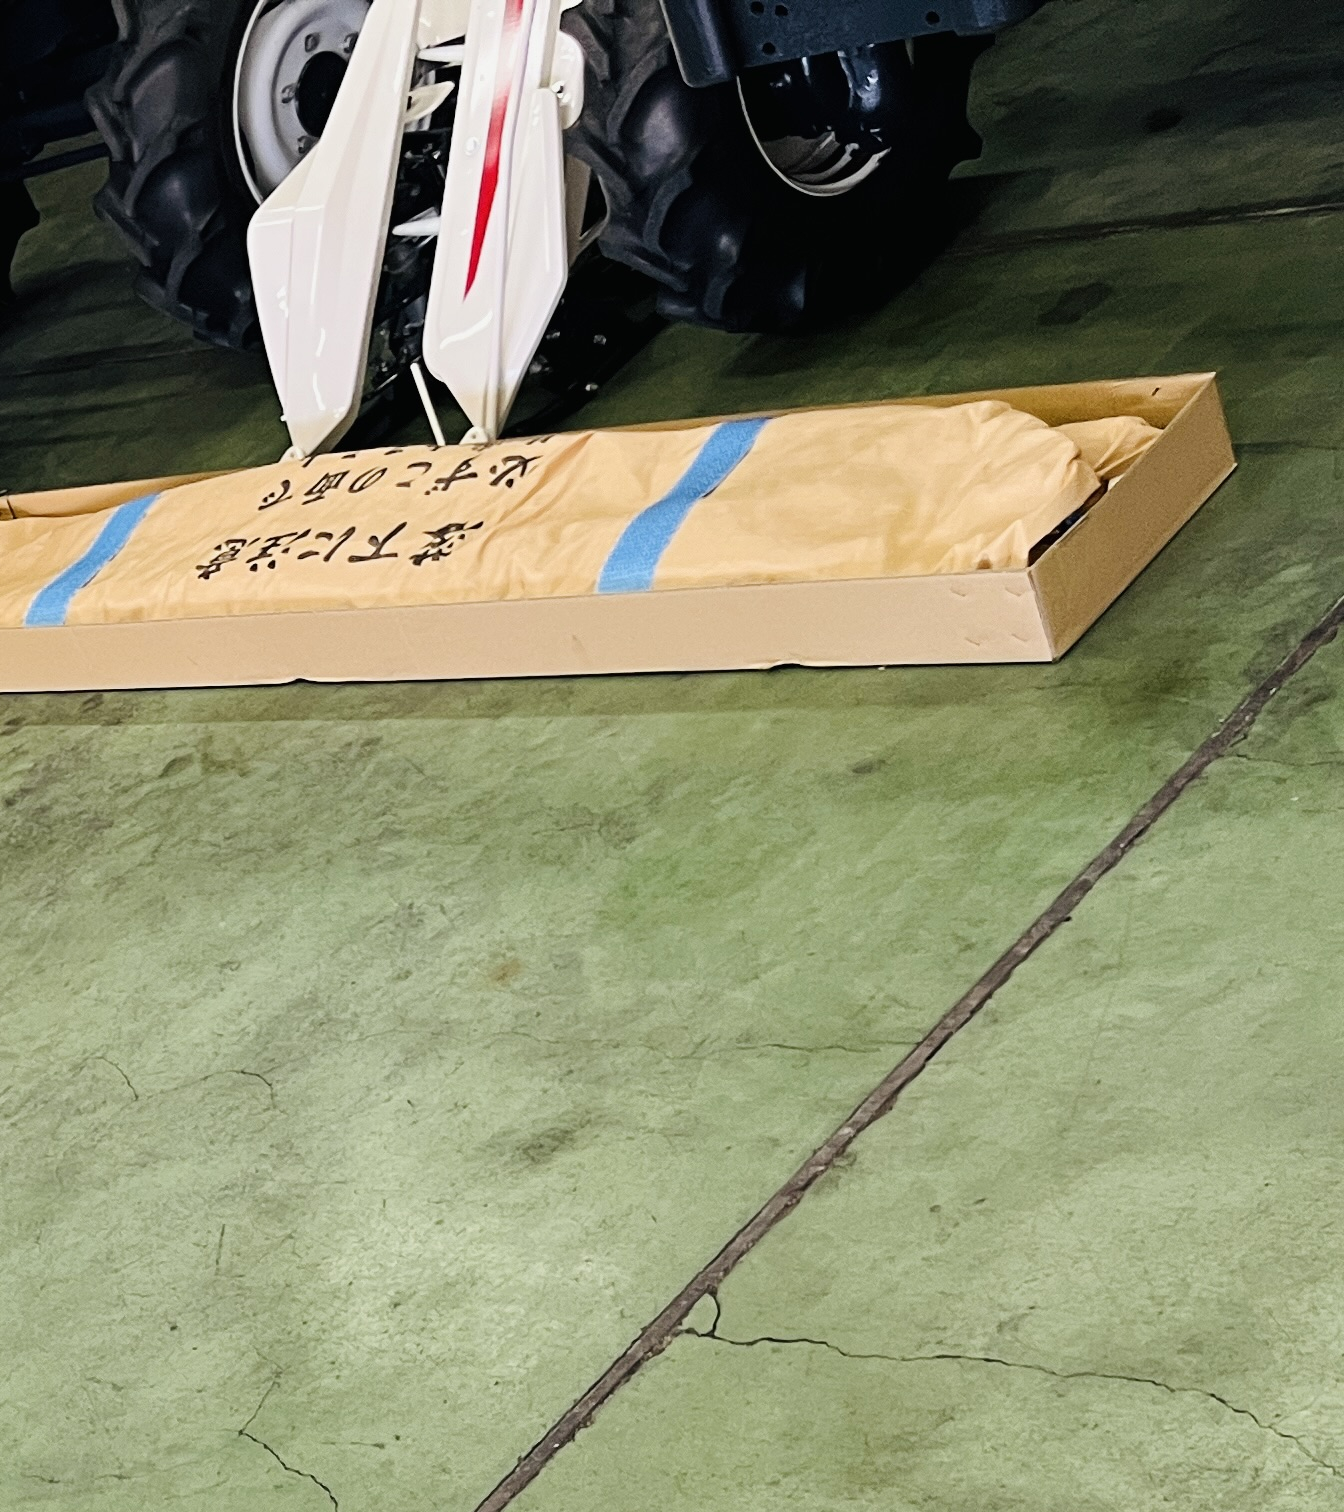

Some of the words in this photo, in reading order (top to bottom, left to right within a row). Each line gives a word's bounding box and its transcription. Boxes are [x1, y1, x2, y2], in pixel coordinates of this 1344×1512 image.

[195, 520, 484, 580] 落下に注意
